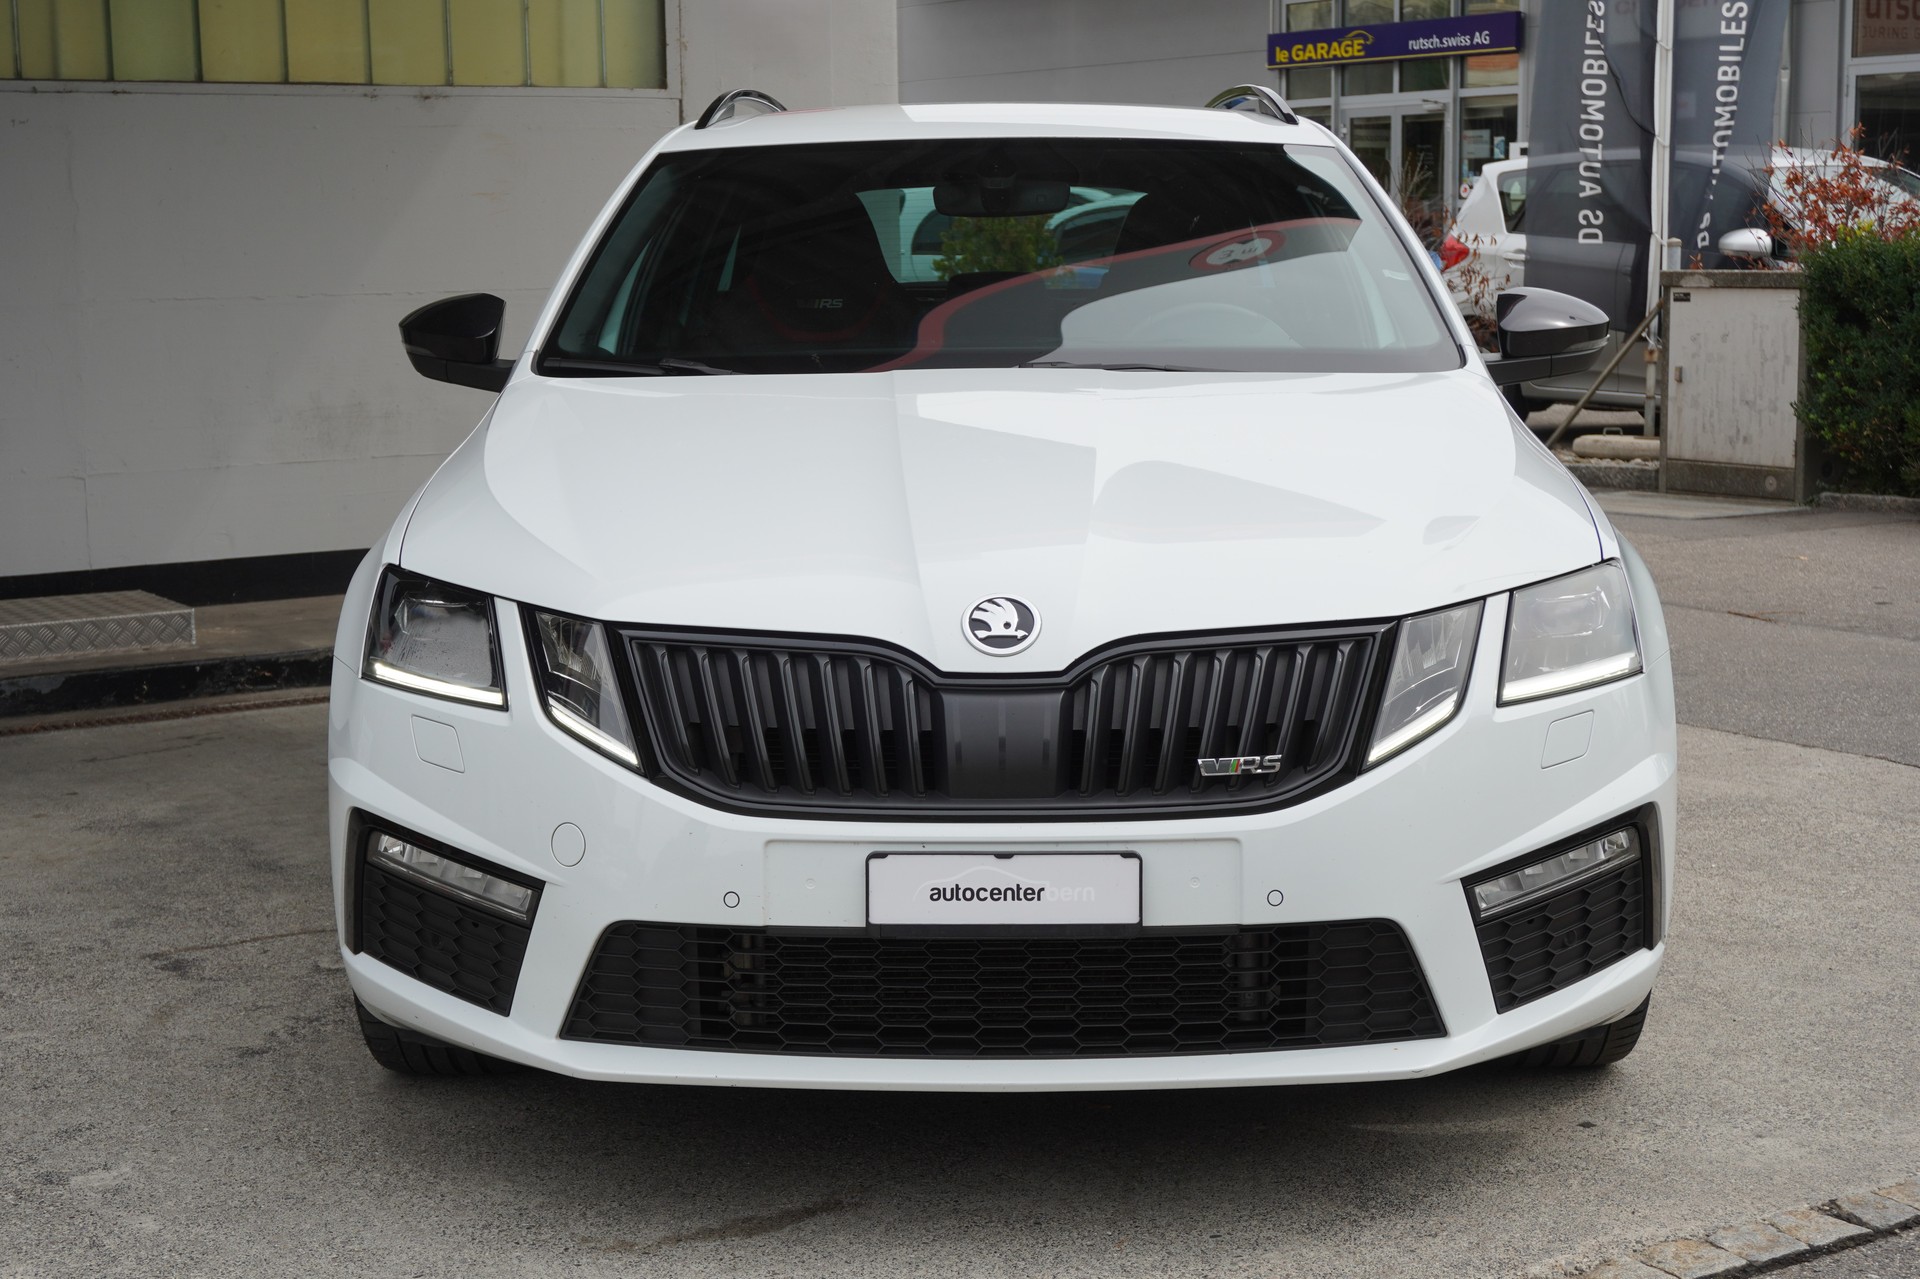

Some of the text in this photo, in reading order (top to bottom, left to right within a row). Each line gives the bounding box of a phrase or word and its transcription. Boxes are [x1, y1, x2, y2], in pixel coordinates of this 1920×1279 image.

[1275, 39, 1365, 62] le GARAGE
[1408, 31, 1490, 50] rutsch.swiss AG
[1710, 1, 1748, 200] TOMOBILES
